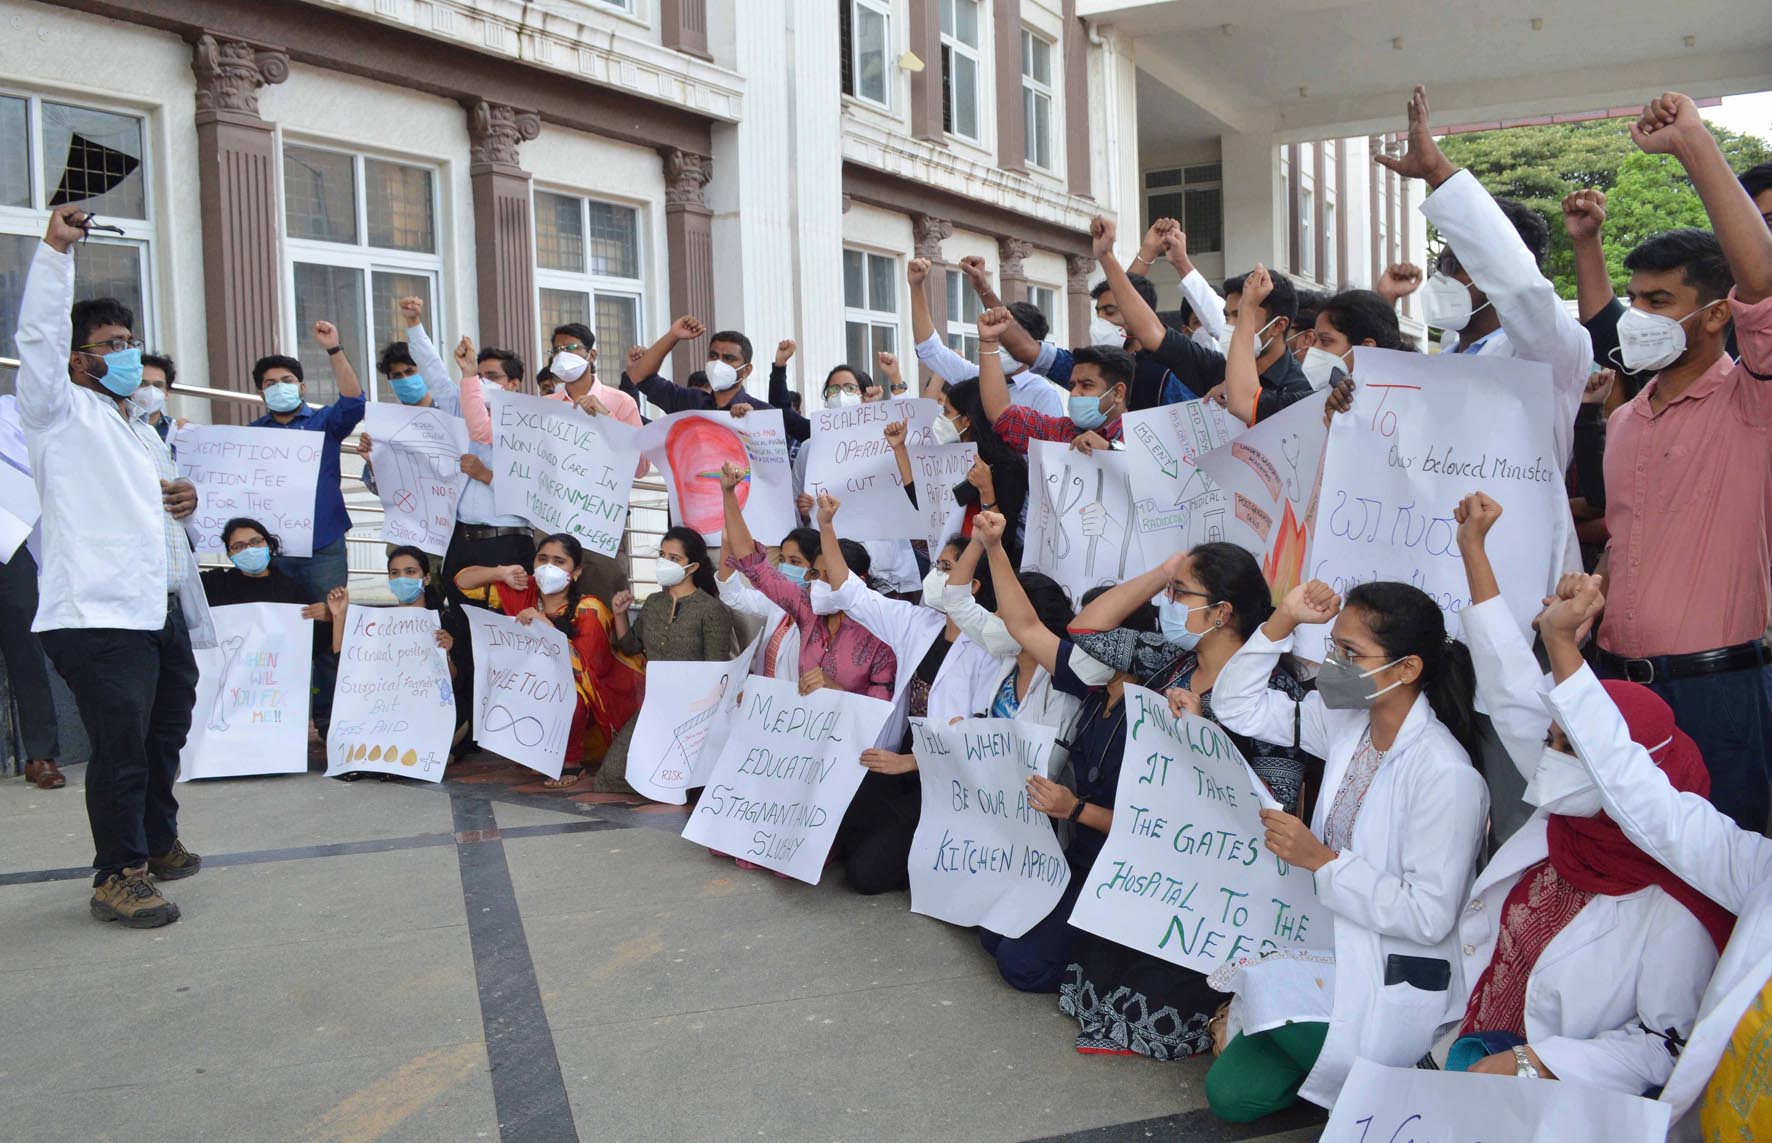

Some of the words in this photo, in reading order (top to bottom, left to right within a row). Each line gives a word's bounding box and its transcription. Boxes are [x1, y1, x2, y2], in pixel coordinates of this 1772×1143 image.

[500, 404, 597, 452] EXCLUSIVE
[819, 402, 889, 432] SCALPELS
[894, 400, 916, 420] TO
[561, 453, 589, 478] CARE
[595, 465, 619, 492] IN
[1151, 441, 1173, 472] ENT
[1422, 444, 1486, 480] beloved
[254, 468, 288, 488] FEE
[508, 460, 532, 480] ALL
[538, 469, 625, 523] GOVERNMENT
[846, 474, 877, 493] CUT
[206, 490, 238, 511] FOR
[242, 491, 274, 512] THE
[272, 511, 312, 530] YEAR
[525, 489, 562, 529] MEDICAL
[747, 692, 843, 743] MEDICAL
[964, 731, 1012, 761] WHEN
[661, 769, 684, 782] RISK
[1192, 766, 1240, 809] TAKE
[951, 779, 970, 812] BE
[977, 788, 1009, 820] OUR
[1130, 804, 1168, 840] THE
[1172, 823, 1259, 866] GATES
[934, 828, 1015, 875] KITCHEN
[1020, 844, 1067, 888] APRON
[1096, 859, 1199, 913] HOSPITAL
[1218, 886, 1250, 929] TO
[1271, 897, 1310, 944] THE
